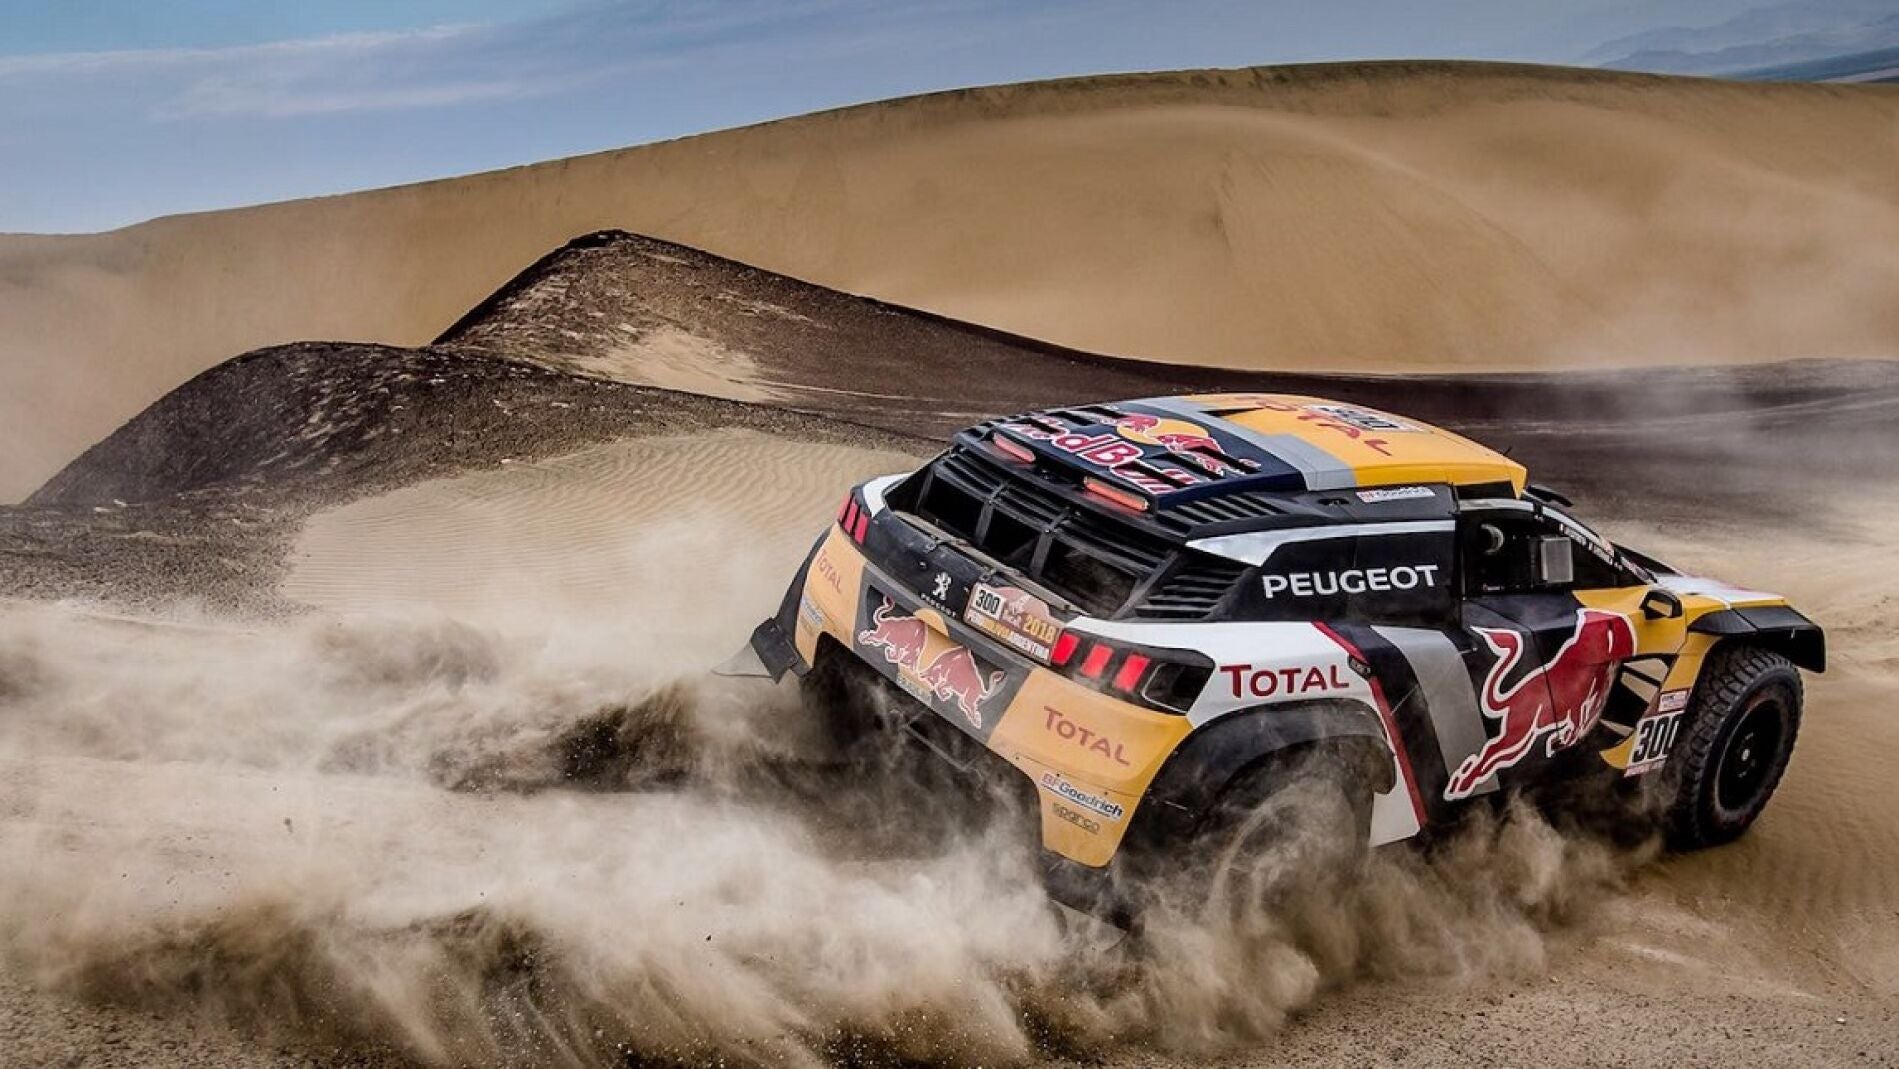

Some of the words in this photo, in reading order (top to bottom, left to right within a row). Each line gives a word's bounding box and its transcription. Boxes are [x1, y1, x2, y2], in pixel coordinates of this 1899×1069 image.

[1262, 565, 1438, 599] PEUGEOT
[975, 590, 1001, 615] 300
[1022, 613, 1057, 644] 2018
[1220, 664, 1350, 698] TOTAL
[1044, 705, 1131, 766] TOTAL
[1042, 772, 1123, 817] BFGoodrich
